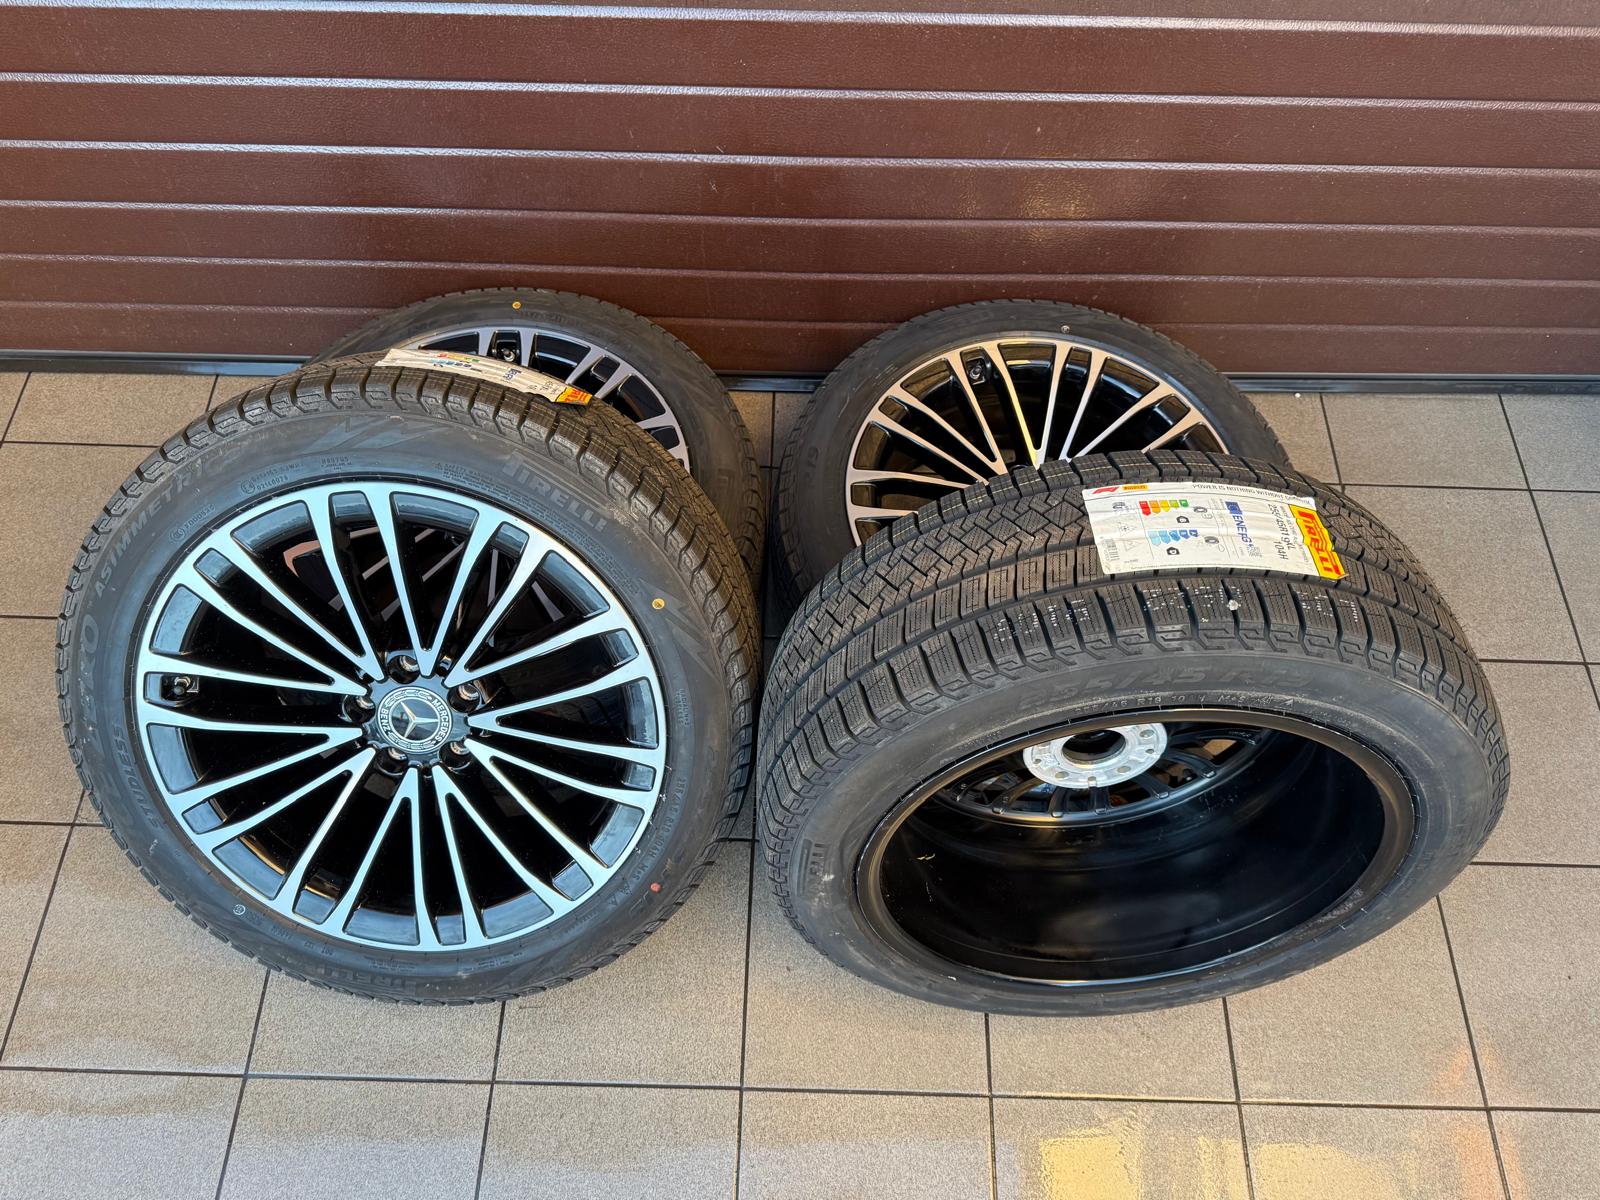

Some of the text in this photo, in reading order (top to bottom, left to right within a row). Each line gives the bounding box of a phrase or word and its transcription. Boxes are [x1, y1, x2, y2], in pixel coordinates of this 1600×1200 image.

[502, 450, 607, 531] PIRELLI
[1226, 486, 1256, 495] NOTHING
[1256, 489, 1284, 500] WITHOUT
[1273, 540, 1288, 560] 104H
[1297, 509, 1344, 577] PIRELLI
[380, 708, 390, 735] BENZ
[432, 698, 449, 742] MERCEDES
